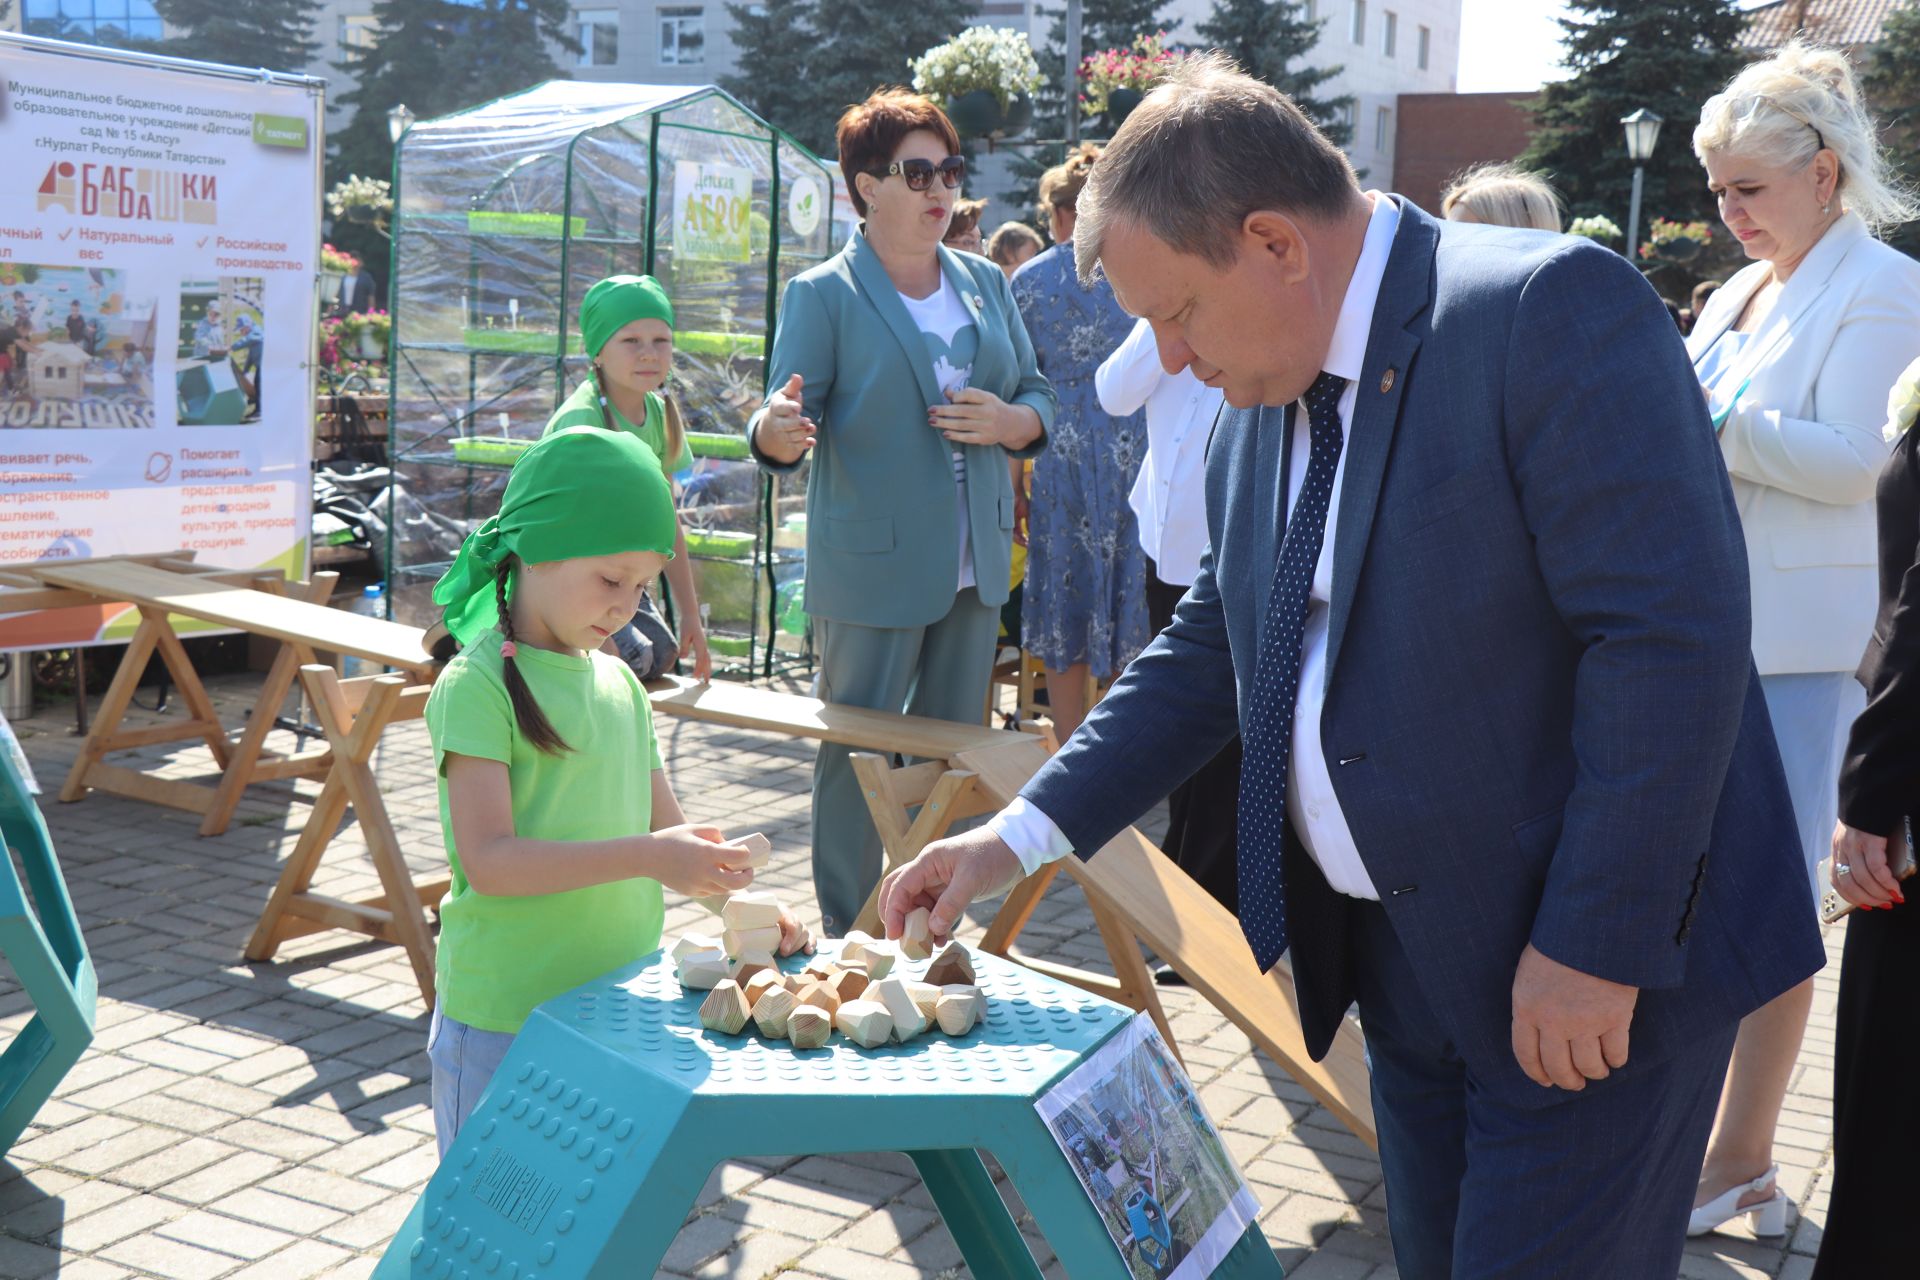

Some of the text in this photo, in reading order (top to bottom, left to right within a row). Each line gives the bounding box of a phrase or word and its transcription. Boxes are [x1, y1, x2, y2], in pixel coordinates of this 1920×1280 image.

[8, 80, 253, 122] Муниципальное бюджетное дошкольное
[14, 100, 251, 137] образовательное учреждение «Детский
[80, 126, 181, 147] сад № 15 «Алсу»
[35, 136, 226, 167] г.Нурлат Республики Татарстан»
[695, 165, 735, 190] Детская
[682, 192, 746, 234] АГРО
[0, 227, 43, 240] чный
[79, 227, 175, 245] Натуральный
[216, 235, 288, 252] Российское
[79, 249, 104, 260] вес
[216, 257, 303, 271] производство
[55, 453, 93, 466] речь,
[180, 448, 240, 460] Помогает
[180, 467, 253, 481] расширить
[181, 484, 277, 499] представления
[181, 502, 217, 516] детей
[226, 499, 271, 514] родной
[181, 517, 297, 534] культуре, природе
[192, 537, 249, 550] социуме.
[0, 546, 71, 560] собности
